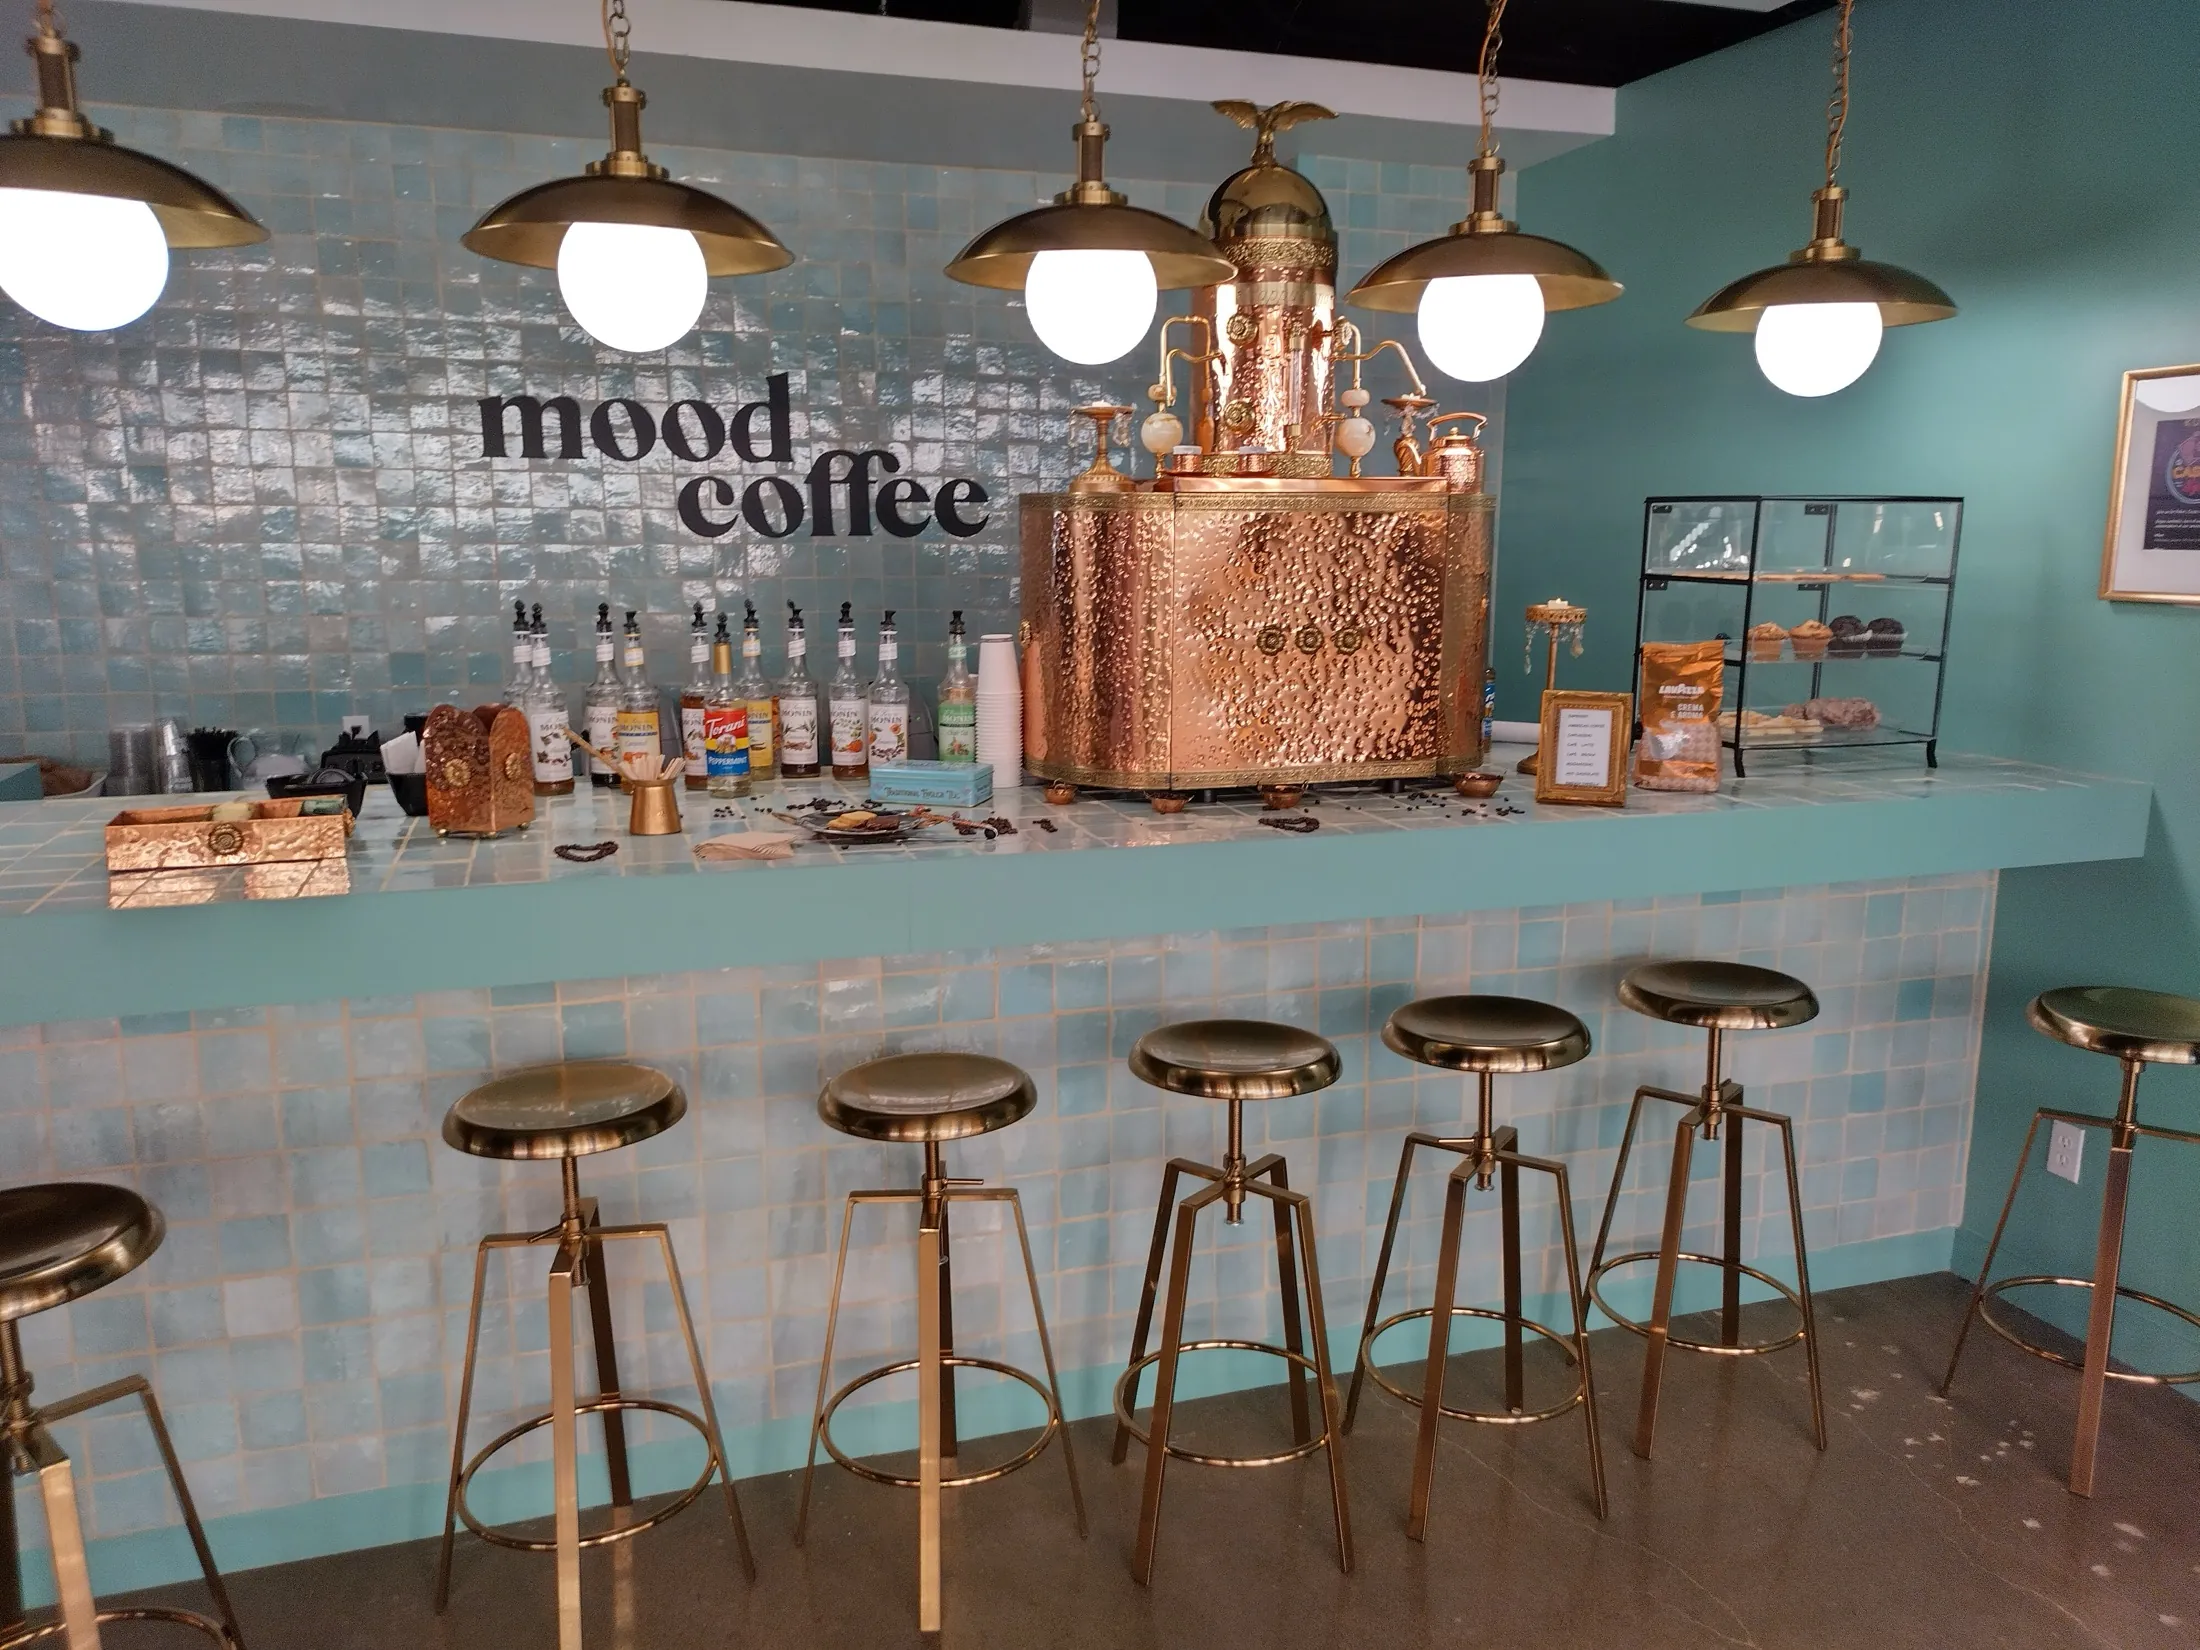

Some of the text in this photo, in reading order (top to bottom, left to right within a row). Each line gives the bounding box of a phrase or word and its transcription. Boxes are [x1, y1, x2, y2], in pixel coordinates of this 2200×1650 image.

[477, 372, 794, 463] mood
[678, 450, 989, 538] coffee
[705, 715, 746, 740] Torani
[1678, 703, 1704, 711] CREMA
